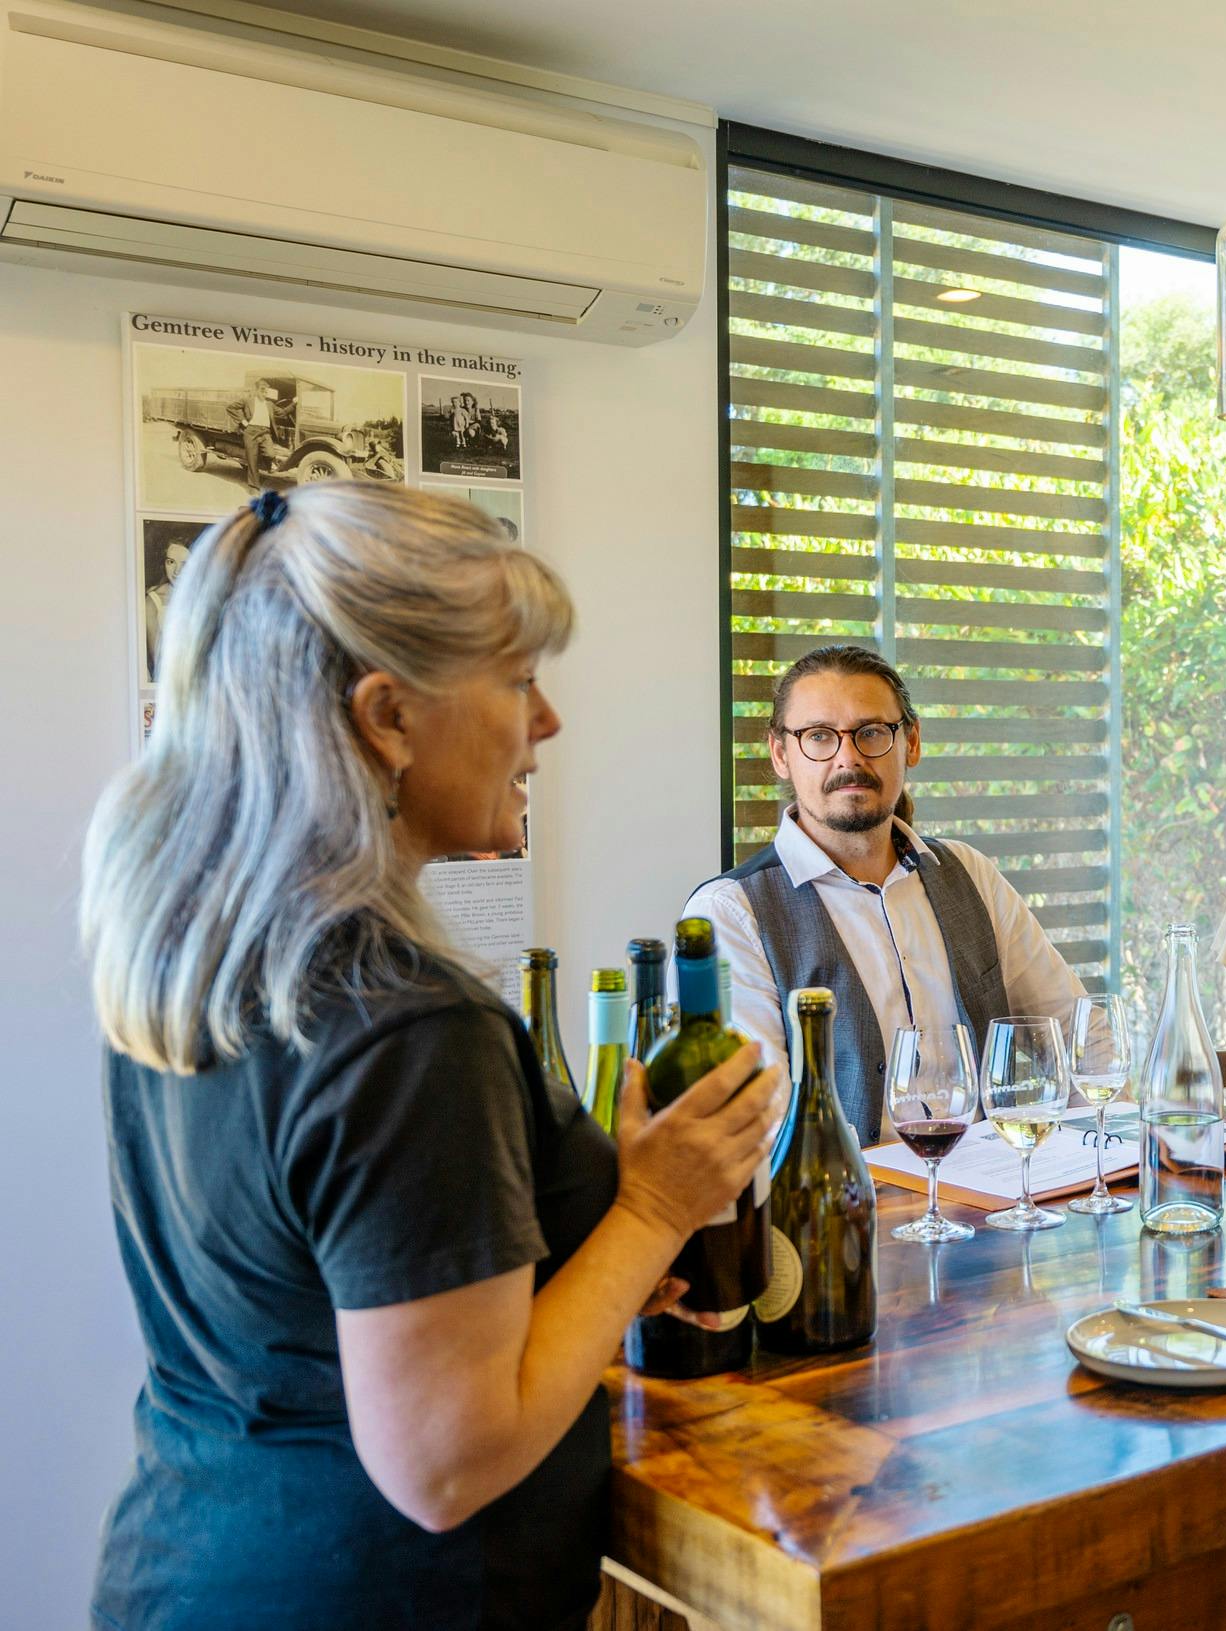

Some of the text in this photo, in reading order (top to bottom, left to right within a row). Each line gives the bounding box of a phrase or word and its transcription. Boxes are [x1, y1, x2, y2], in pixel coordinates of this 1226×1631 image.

[31, 173, 65, 184] DAIKIN
[131, 313, 225, 340] Gemtree
[231, 325, 294, 349] Wines
[319, 336, 387, 364] history
[393, 345, 411, 362] in
[417, 349, 446, 366] the
[451, 355, 522, 380] making.
